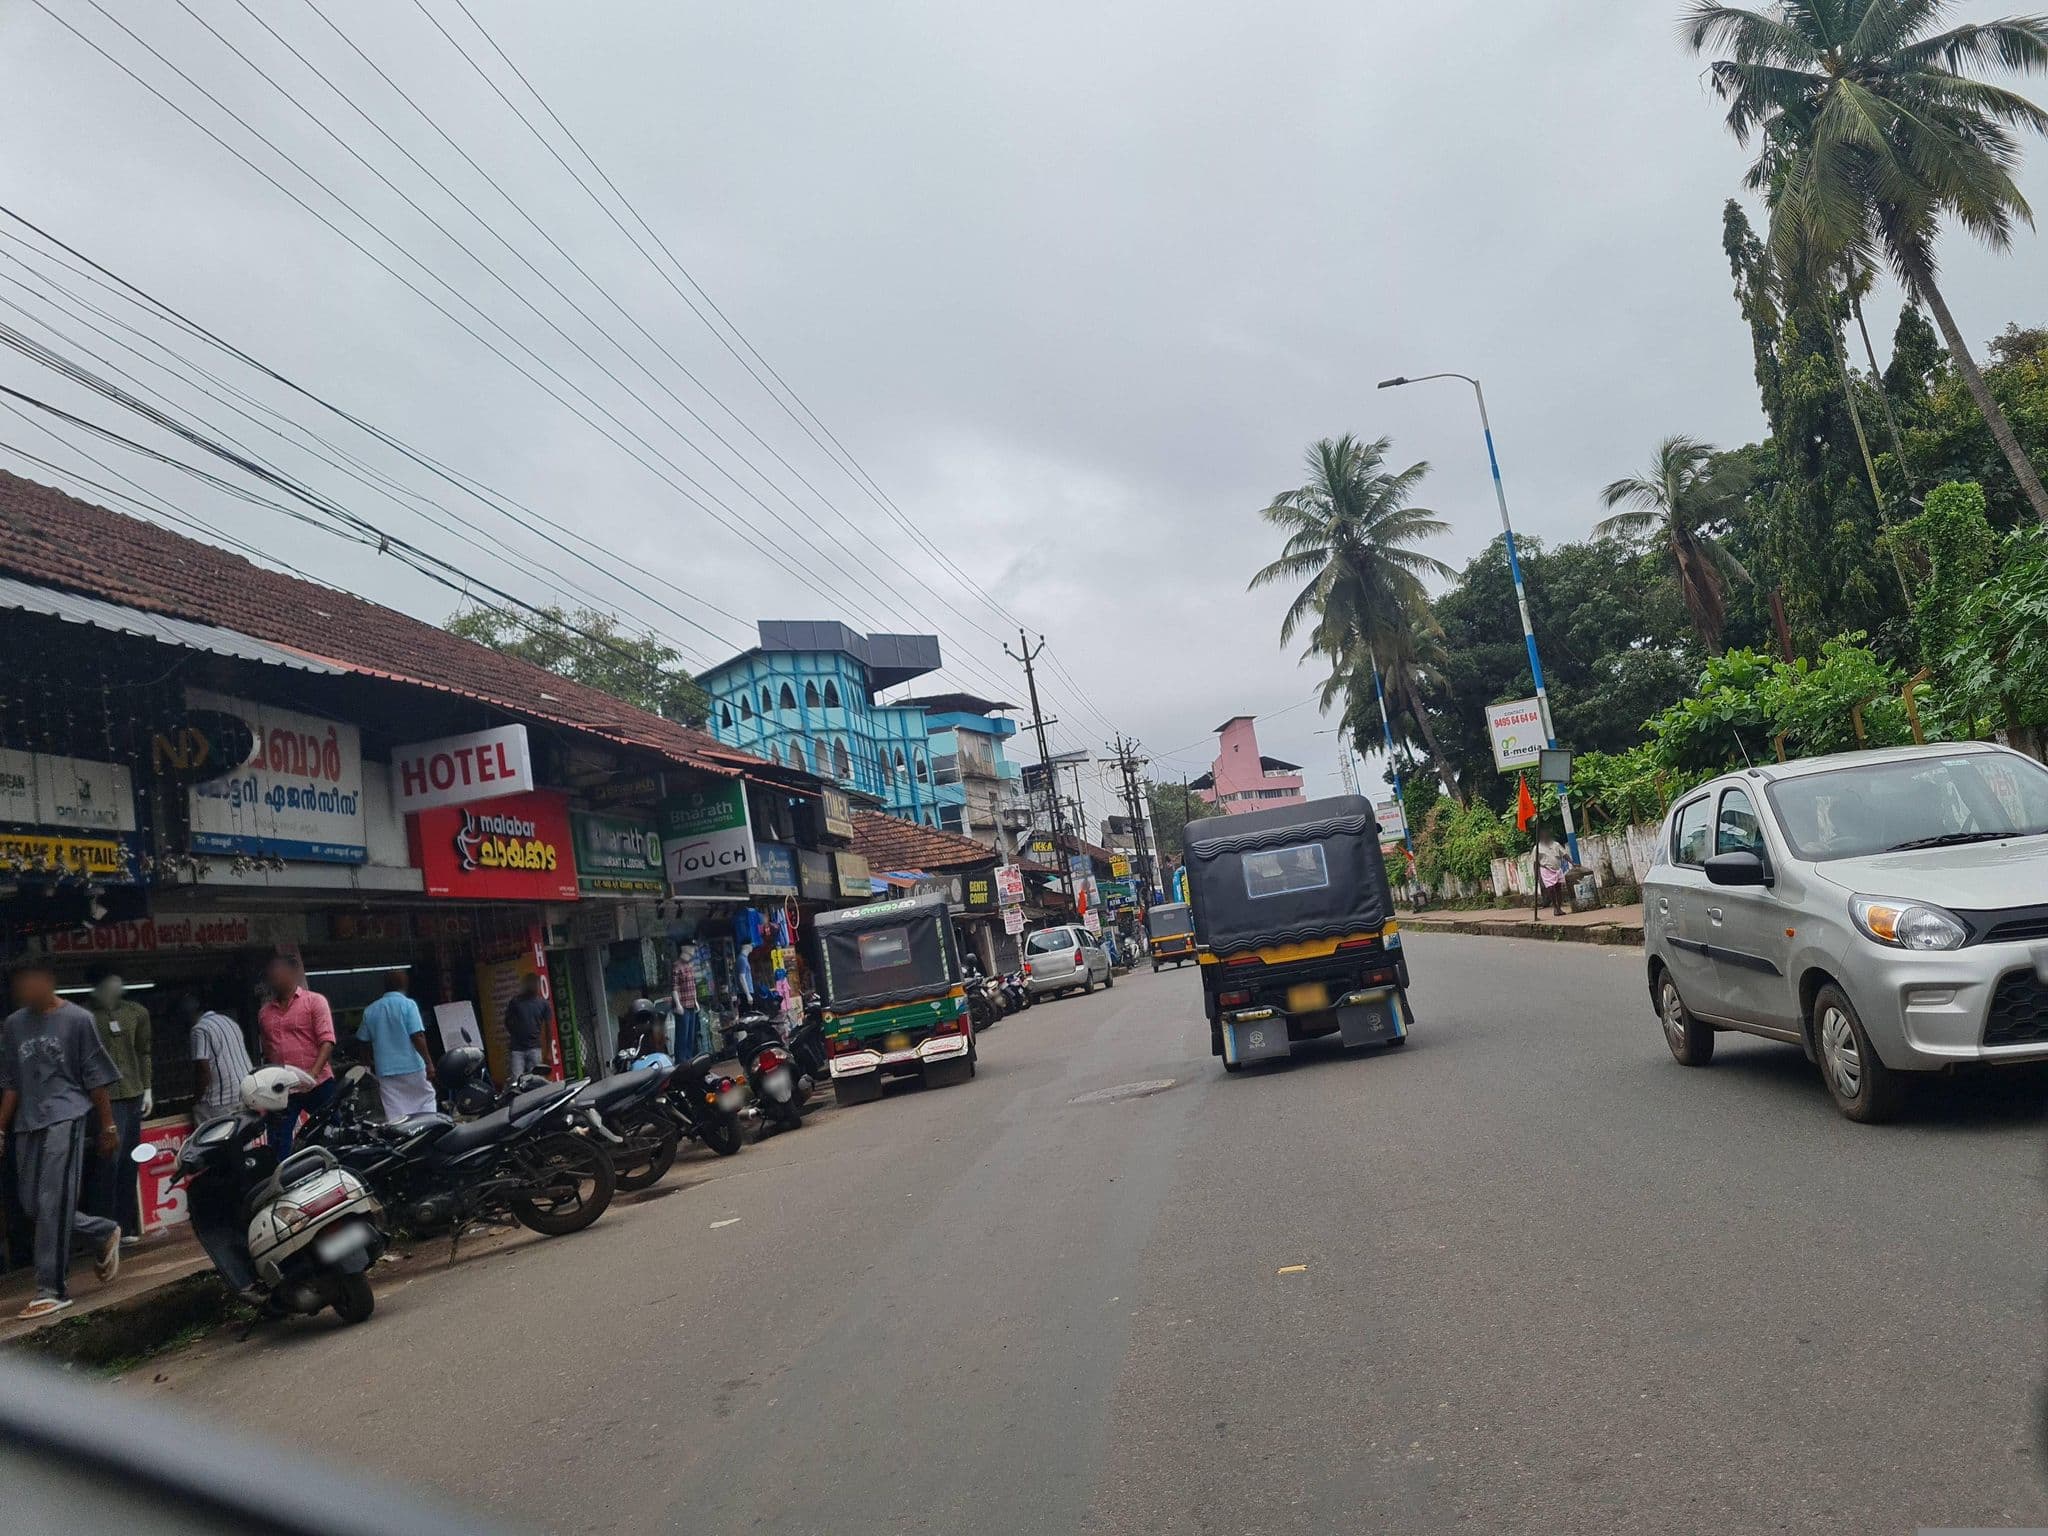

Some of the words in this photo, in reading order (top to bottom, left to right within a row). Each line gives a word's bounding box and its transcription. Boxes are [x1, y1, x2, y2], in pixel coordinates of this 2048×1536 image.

[1503, 744, 1542, 757] B-media
[401, 742, 516, 797] HOTEL
[671, 799, 733, 824] Bharath
[480, 813, 536, 838] malabar
[479, 836, 557, 871] ചായക്കട
[969, 880, 988, 892] GENTS
[969, 892, 988, 905] COURT
